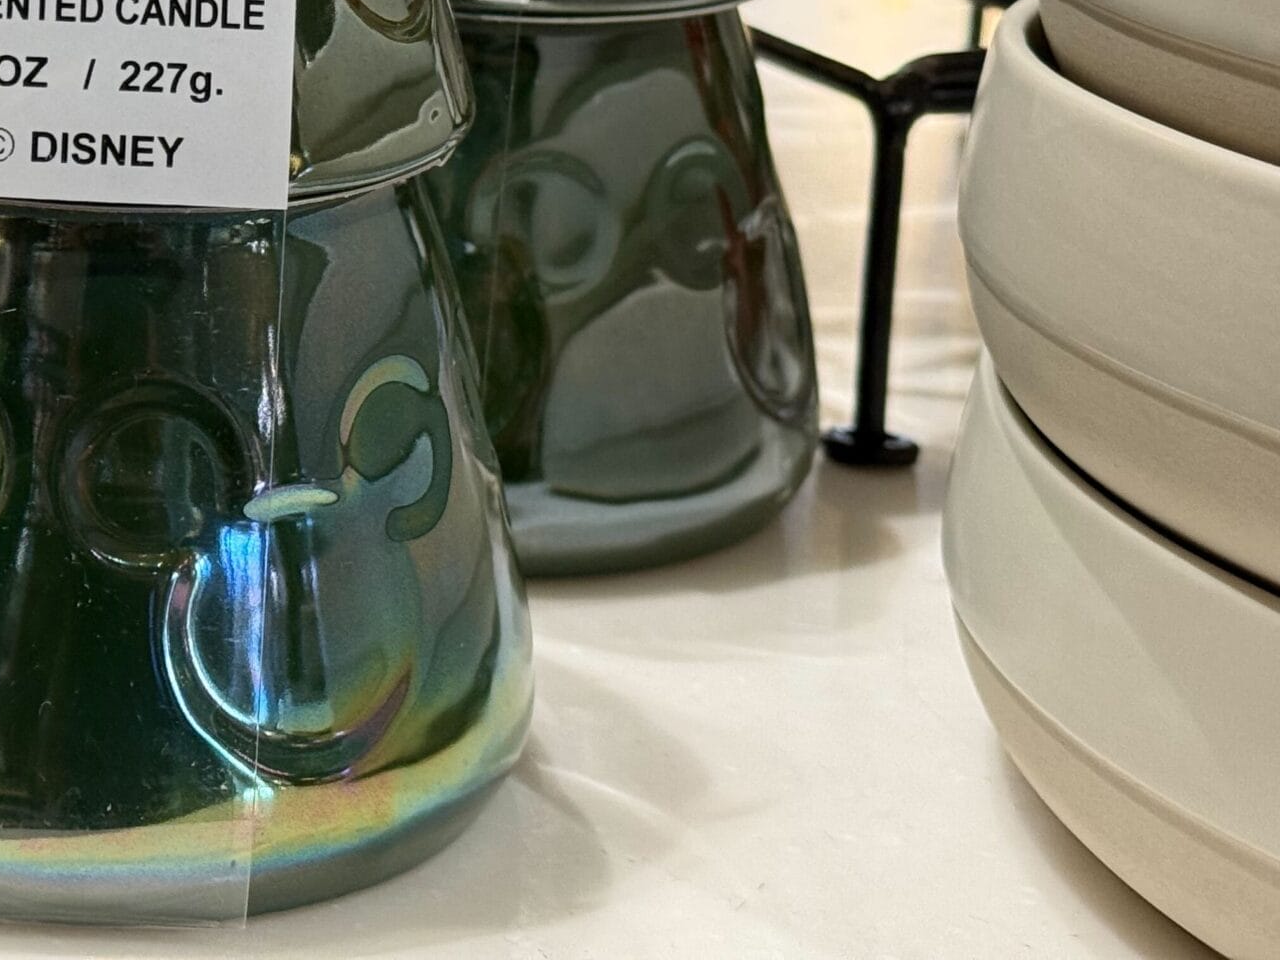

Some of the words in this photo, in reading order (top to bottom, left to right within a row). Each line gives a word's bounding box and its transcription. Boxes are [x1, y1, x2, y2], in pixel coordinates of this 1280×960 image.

[83, 59, 96, 90] /
[119, 61, 223, 103] 227g.
[31, 131, 184, 167] DISNEY
